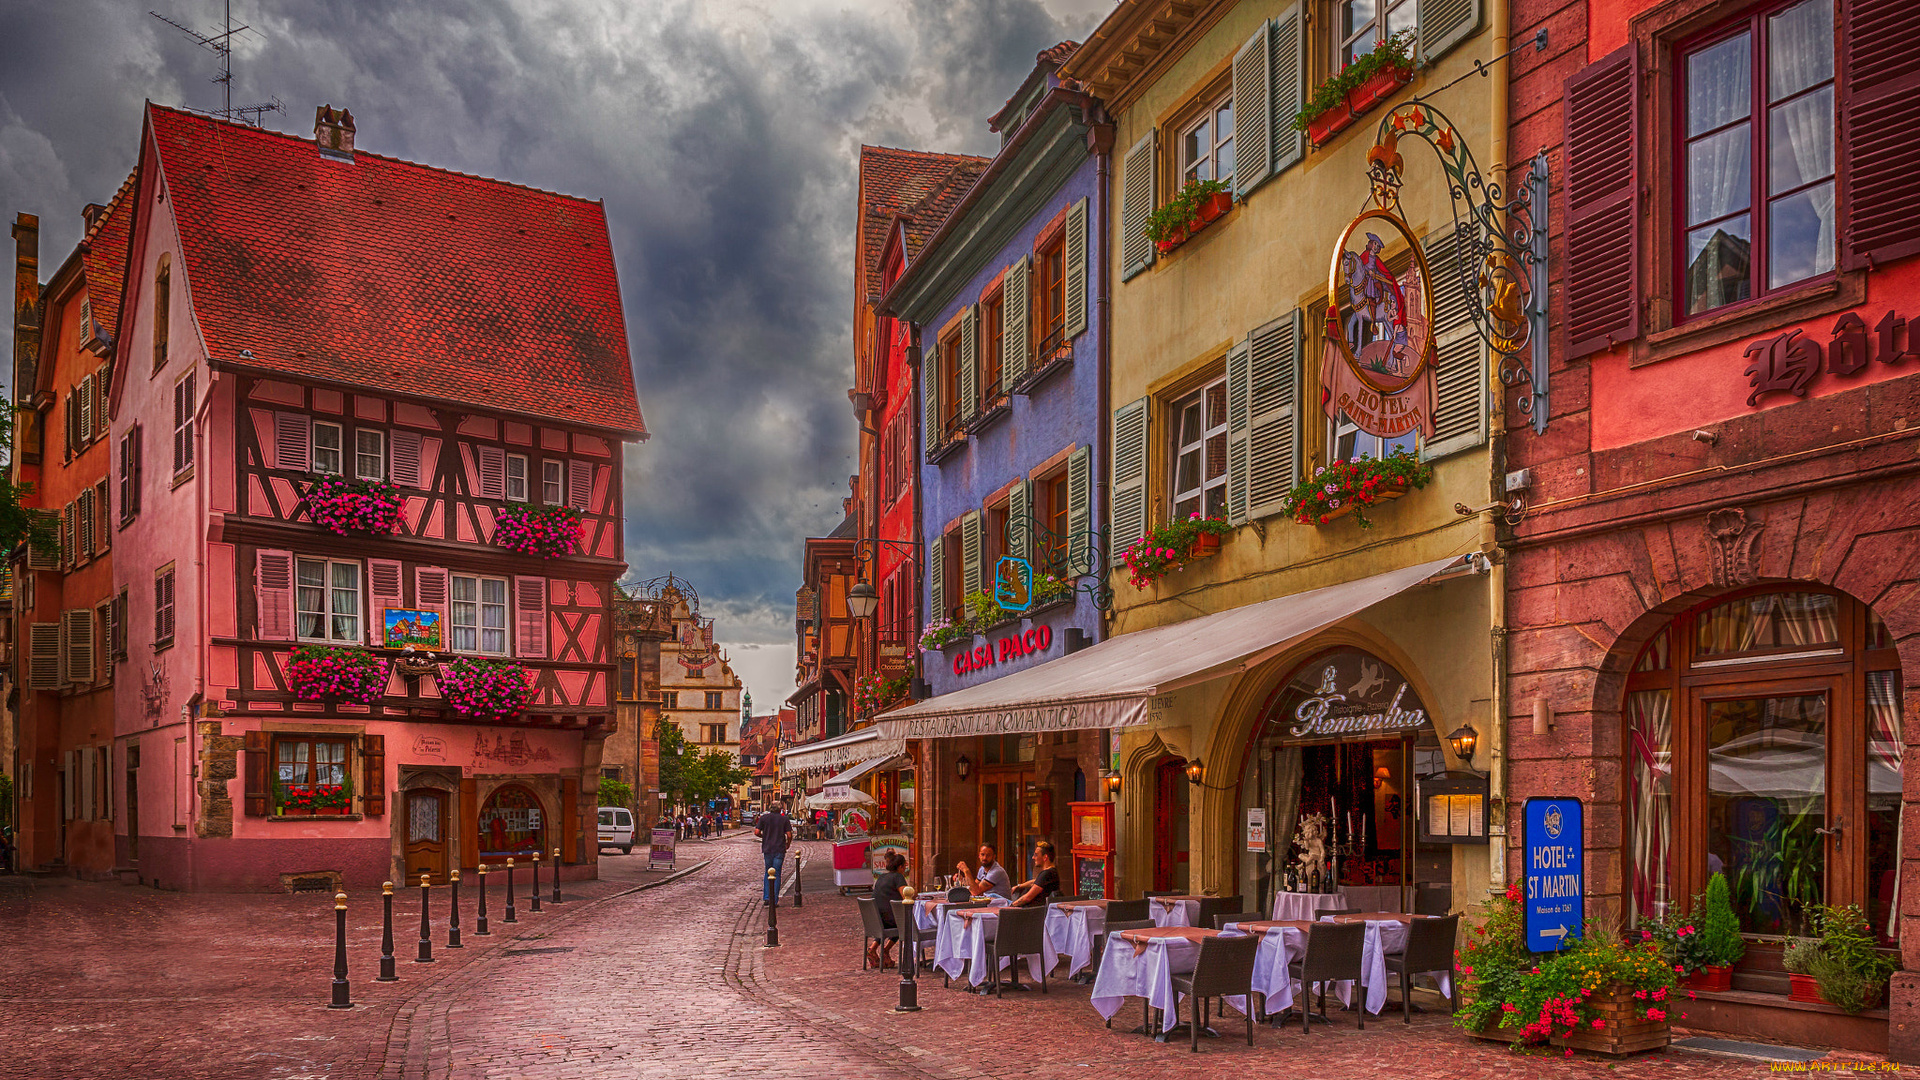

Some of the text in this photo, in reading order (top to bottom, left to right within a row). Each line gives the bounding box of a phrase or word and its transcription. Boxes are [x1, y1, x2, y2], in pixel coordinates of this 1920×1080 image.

[1338, 393, 1422, 434] SAINT-MARTIN
[1356, 387, 1407, 415] HOTEL
[953, 625, 1051, 675] CASA PACO
[908, 706, 1078, 736] RESTAURANT LA ROMANTICA
[1533, 846, 1567, 869] HOTEL
[1528, 874, 1579, 899] ST MARTIN
[1536, 905, 1553, 914] Maison
[1554, 904, 1561, 913] de
